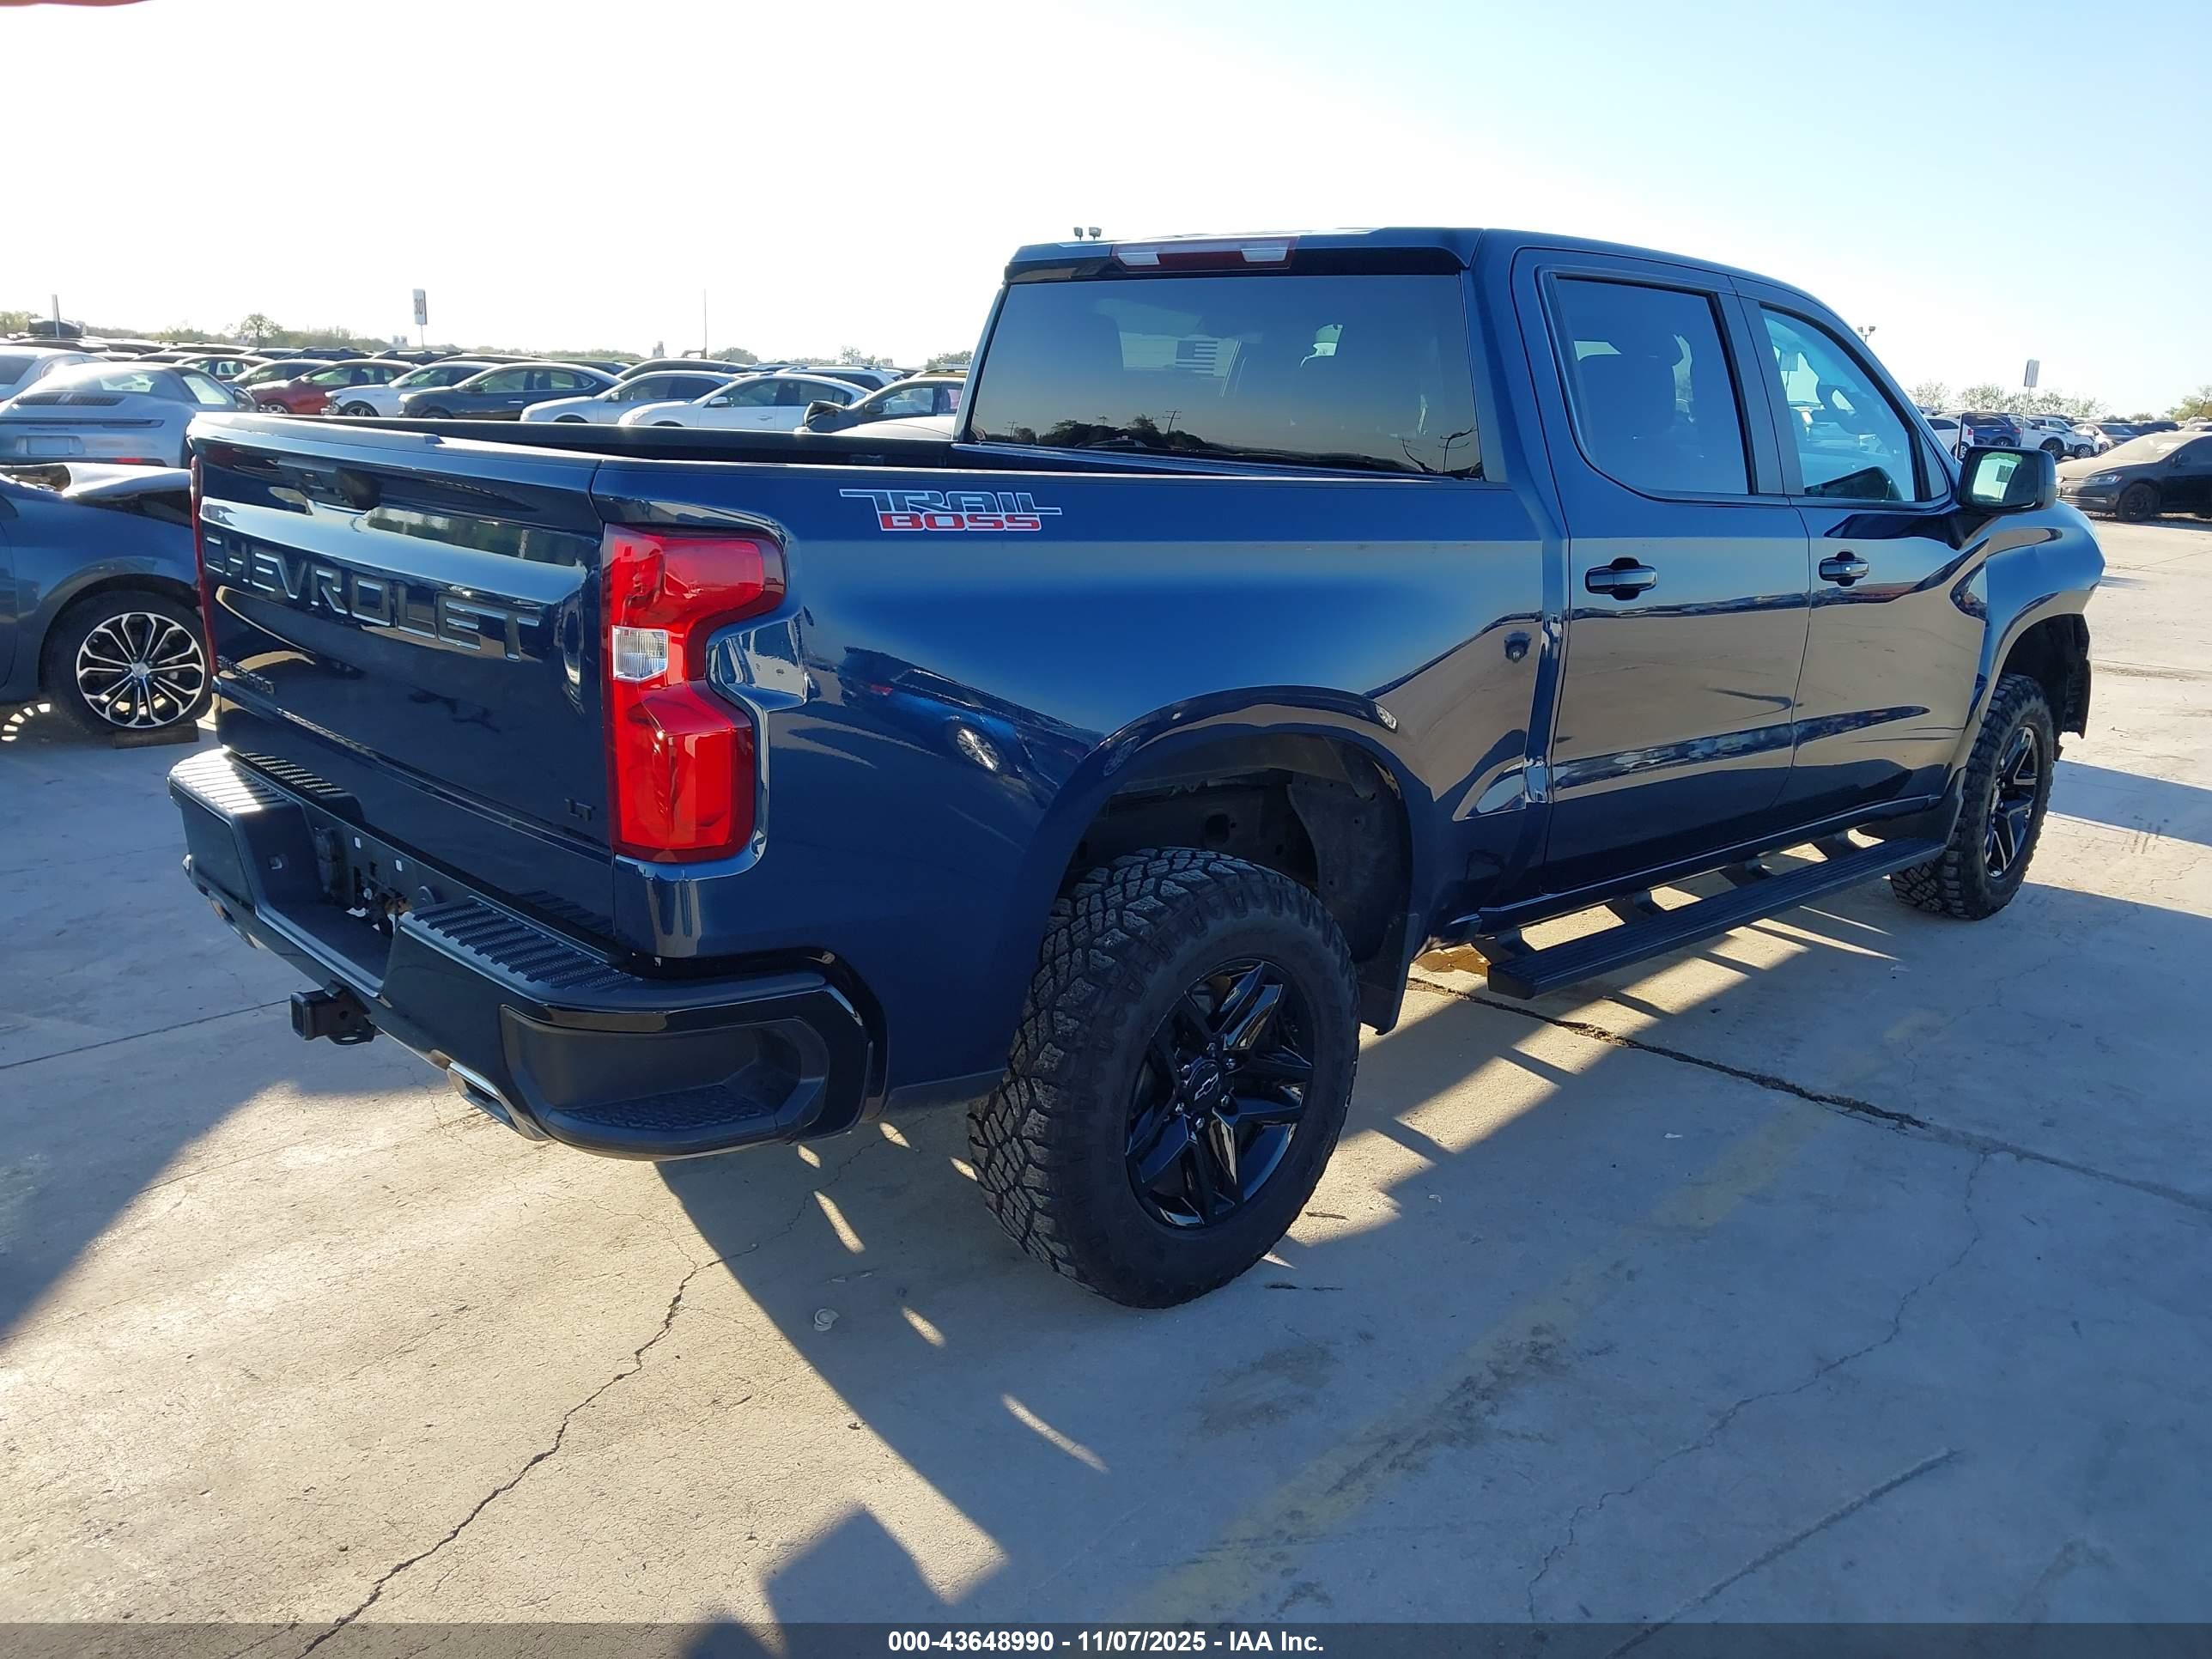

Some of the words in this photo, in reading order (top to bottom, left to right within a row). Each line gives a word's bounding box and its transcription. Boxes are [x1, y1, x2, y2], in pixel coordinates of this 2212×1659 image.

[839, 489, 1062, 515] TRAIL
[878, 513, 1042, 531] BOSS
[204, 533, 540, 662] CHEVROLET
[564, 798, 592, 822] LT
